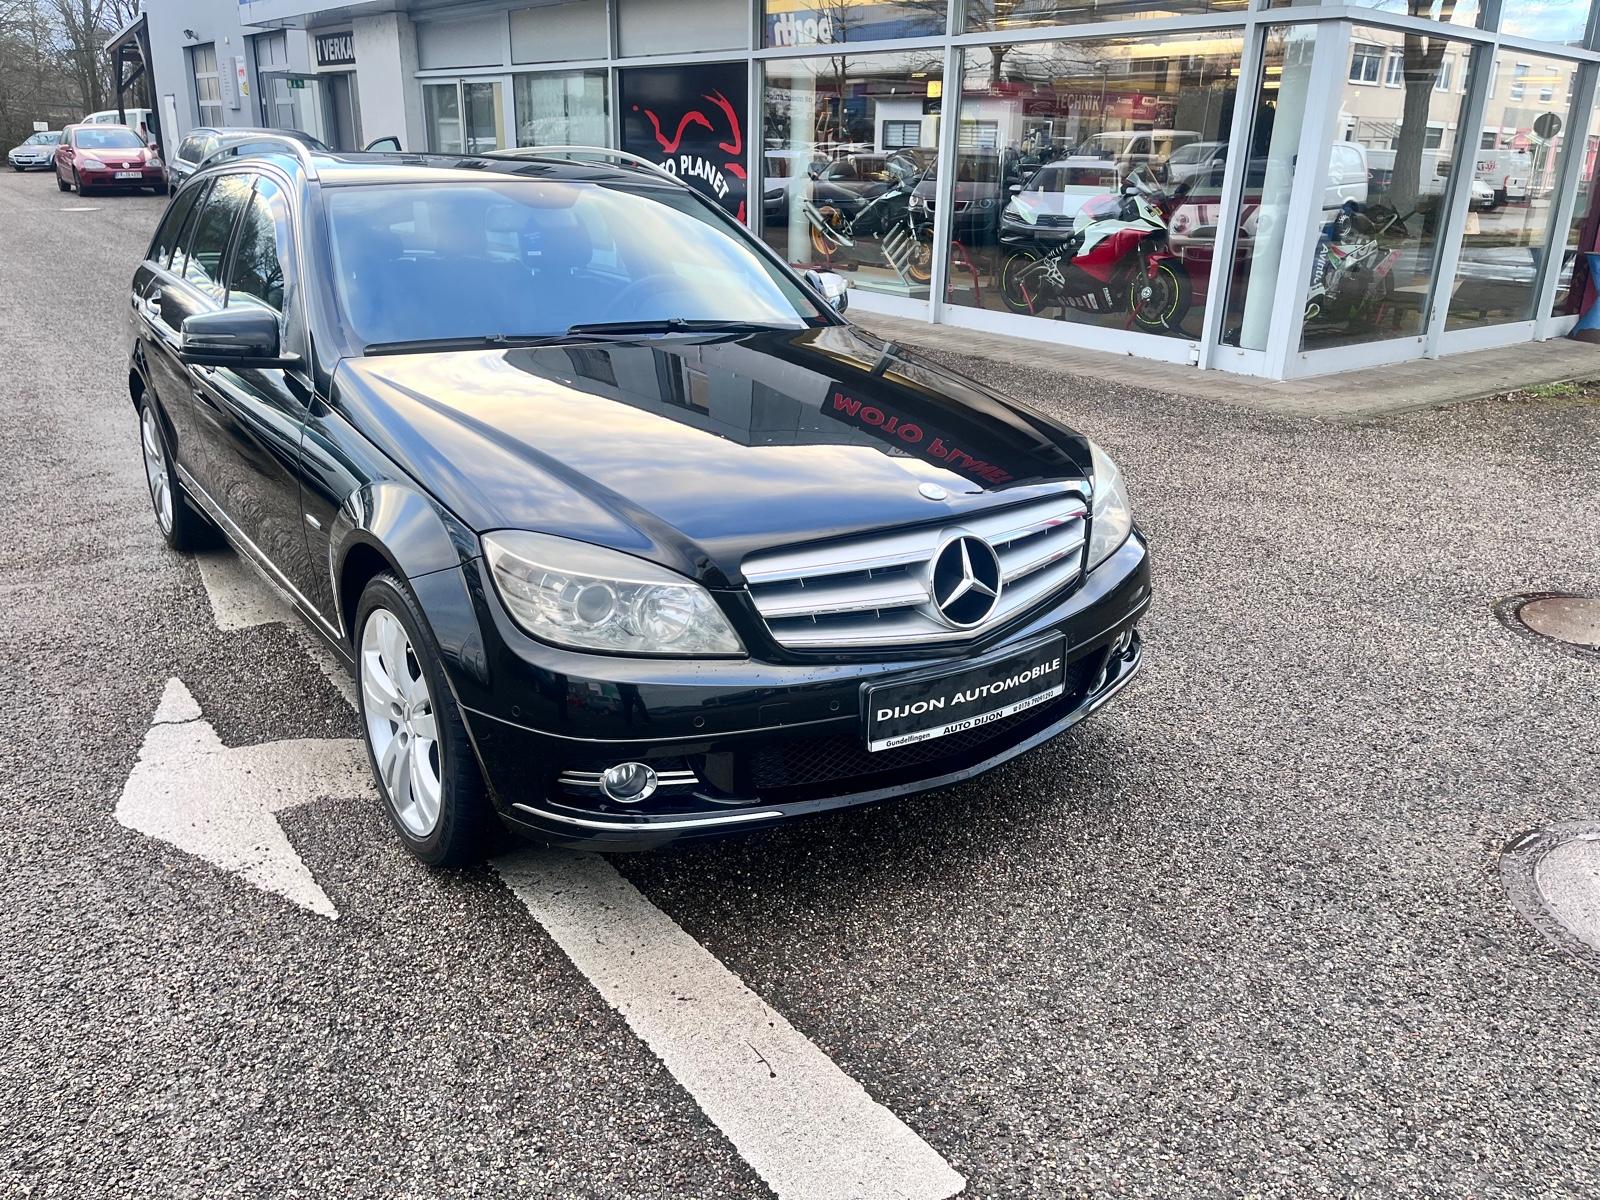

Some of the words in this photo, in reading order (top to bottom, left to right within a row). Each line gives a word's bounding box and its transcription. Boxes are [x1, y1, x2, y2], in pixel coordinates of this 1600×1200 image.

[680, 155, 729, 199] PLANET
[876, 697, 945, 722] DIJON
[950, 658, 1061, 706] AUTOMOBILE
[886, 732, 931, 747] Gundelfingen
[943, 721, 971, 735] AUTO
[974, 710, 1003, 726] DIJON
